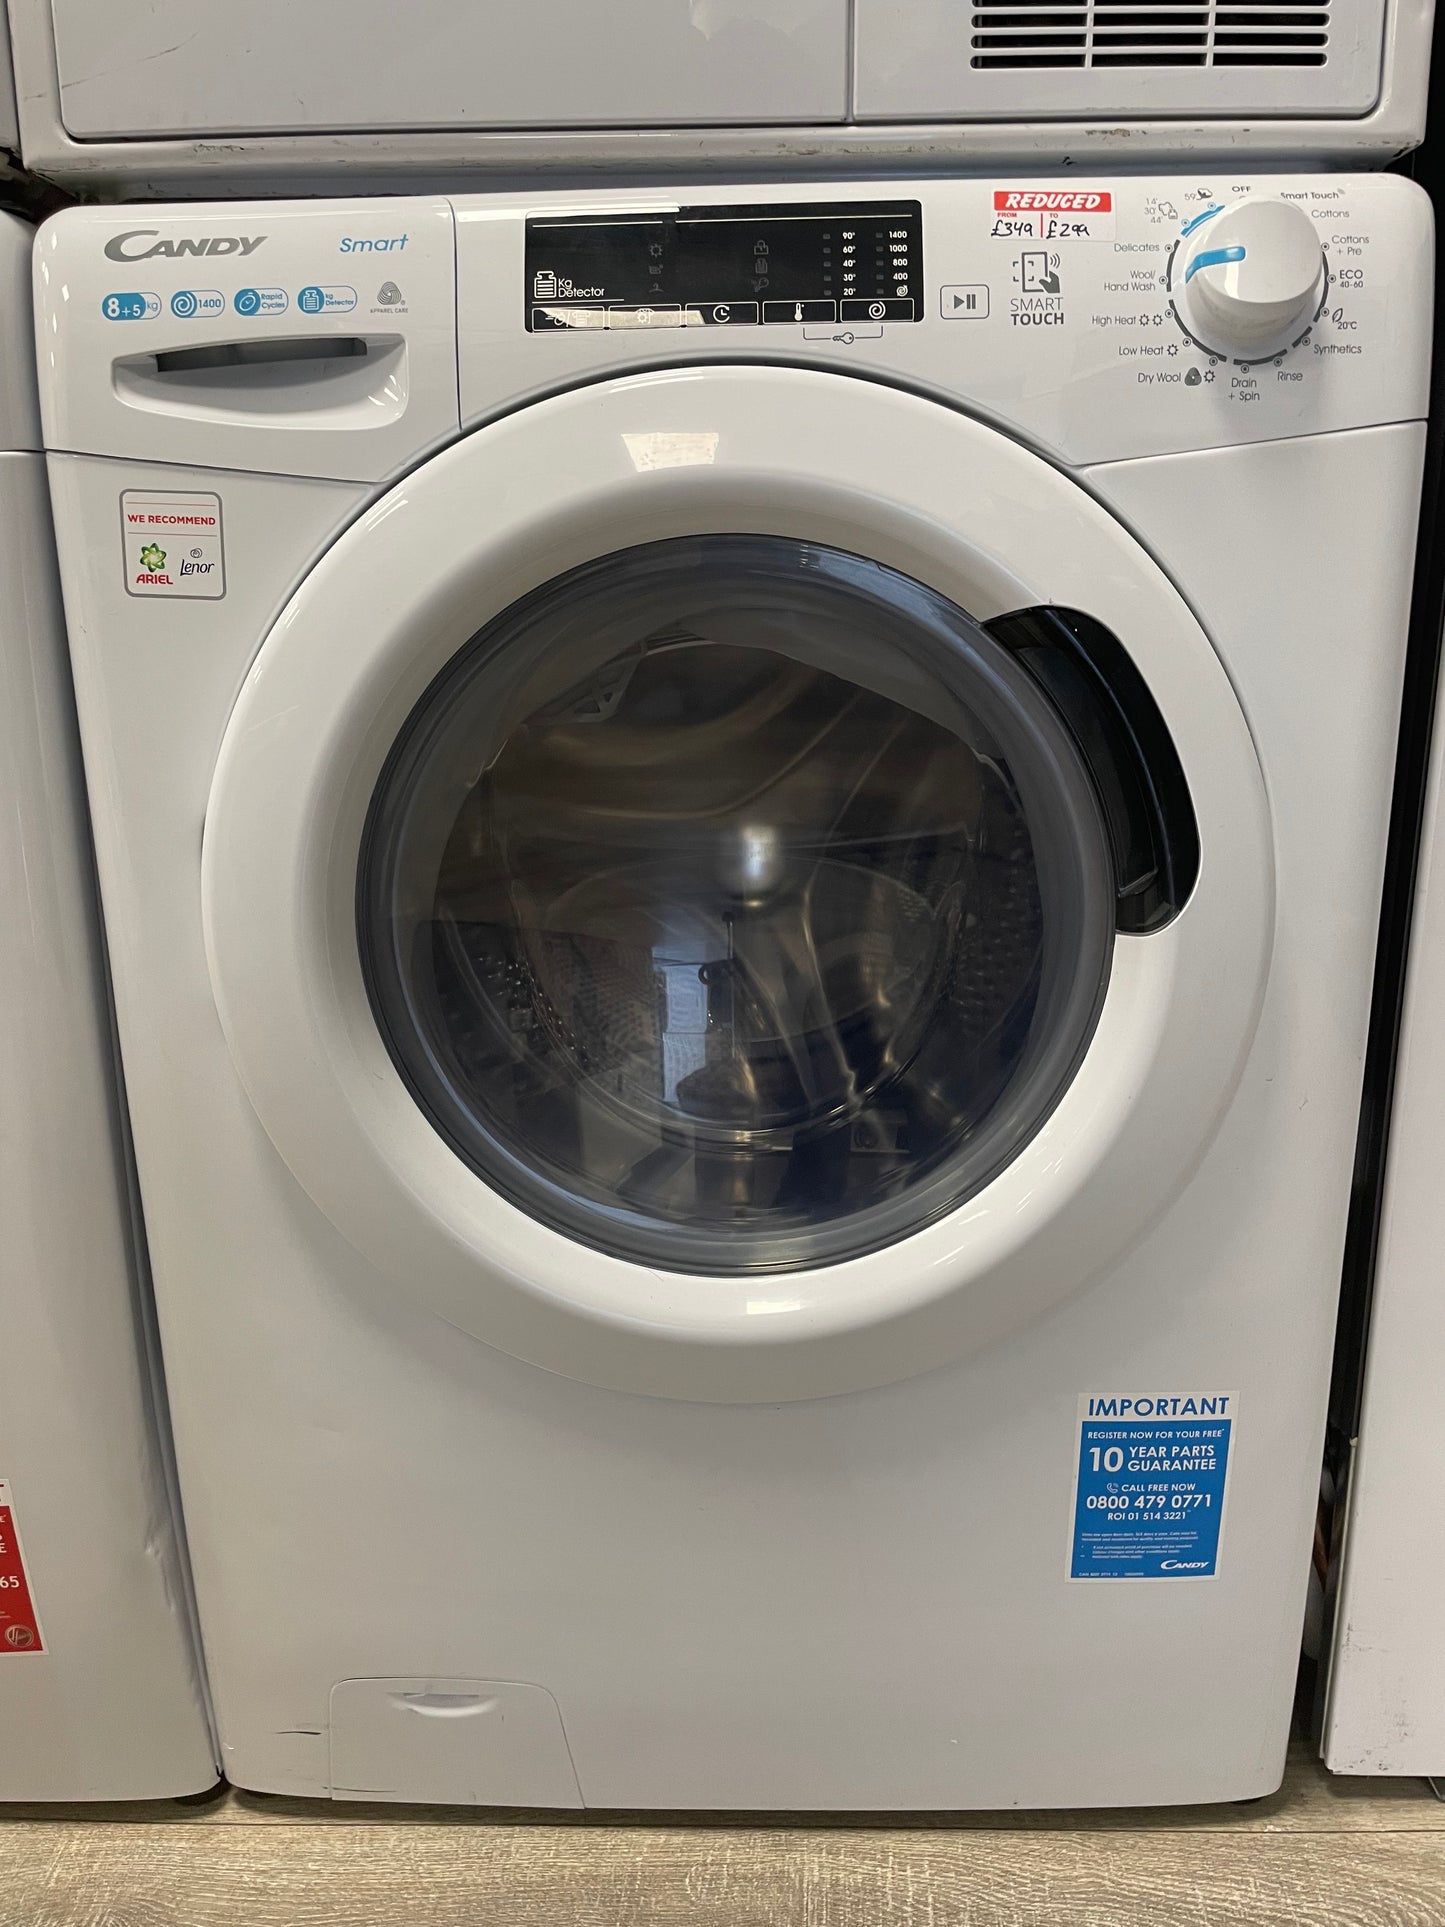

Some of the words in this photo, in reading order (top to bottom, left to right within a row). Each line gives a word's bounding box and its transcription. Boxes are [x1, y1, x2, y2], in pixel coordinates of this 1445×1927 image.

[1005, 193, 1101, 209] REDUCED
[1280, 192, 1308, 200] Smart
[1311, 192, 1339, 200] Touch
[1311, 209, 1350, 218] Cottons
[990, 219, 1033, 237] £349
[1046, 220, 1090, 239] £299
[842, 231, 856, 240] 90°
[889, 231, 908, 239] 1400
[1331, 235, 1370, 244] Cottons
[104, 230, 268, 263] CANDY
[339, 234, 409, 253] Smart
[889, 244, 908, 252] 1000
[1114, 243, 1160, 253] Delicates
[842, 245, 856, 254] 60°
[1347, 247, 1362, 256] Pre
[842, 259, 856, 267] 40°
[892, 258, 908, 266] 800
[843, 273, 856, 281] 30°
[892, 272, 908, 280] 400
[1130, 270, 1156, 279] Wool/
[1339, 269, 1363, 280] ECO
[558, 278, 572, 290] Kg
[1104, 282, 1129, 291] Hand
[1132, 282, 1156, 291] Wash
[1339, 280, 1364, 289] 40-60
[558, 287, 605, 298] Detector
[843, 287, 856, 296] 20°
[260, 293, 283, 302] Rapid
[147, 301, 158, 311] kg
[198, 299, 222, 308] 1400
[261, 301, 285, 310] Cycles
[325, 299, 354, 307] Detector
[1010, 297, 1064, 312] SMART
[1011, 313, 1064, 326] TOUCH
[1092, 316, 1112, 327] High
[1114, 316, 1136, 325] Heat
[1119, 346, 1138, 356] Low
[1140, 346, 1164, 356] Heat
[1313, 344, 1362, 355] Synthetics
[1138, 373, 1154, 384] Dry
[1157, 373, 1181, 383] Wool
[1277, 371, 1303, 381] Rinse
[1231, 378, 1257, 388] Drain
[1239, 391, 1260, 402] Spin
[127, 514, 145, 523] WE
[148, 515, 216, 525] RECOMMEND
[180, 559, 215, 576] Lenor
[136, 574, 173, 584] ARIEL
[1088, 1397, 1230, 1416] IMPORTANT
[1087, 1431, 1128, 1439] REGISTER
[1130, 1431, 1153, 1439] NOW
[1155, 1431, 1173, 1439] FOR
[1175, 1430, 1200, 1438] YOUR
[1129, 1446, 1166, 1458] YEAR
[1171, 1445, 1215, 1457] PARTS
[1089, 1446, 1124, 1472] 10
[1127, 1458, 1217, 1472] GUARANTEE
[1121, 1484, 1145, 1492] CALL
[1147, 1484, 1169, 1492] FREE
[1171, 1483, 1196, 1491] NOW
[1086, 1496, 1129, 1509] 0800
[1134, 1495, 1166, 1509] 479
[1171, 1494, 1212, 1508] 0771
[1107, 1512, 1126, 1520] ROI
[1128, 1512, 1139, 1520] 01
[1143, 1512, 1160, 1520] 514
[1160, 1559, 1209, 1570] CANDY
